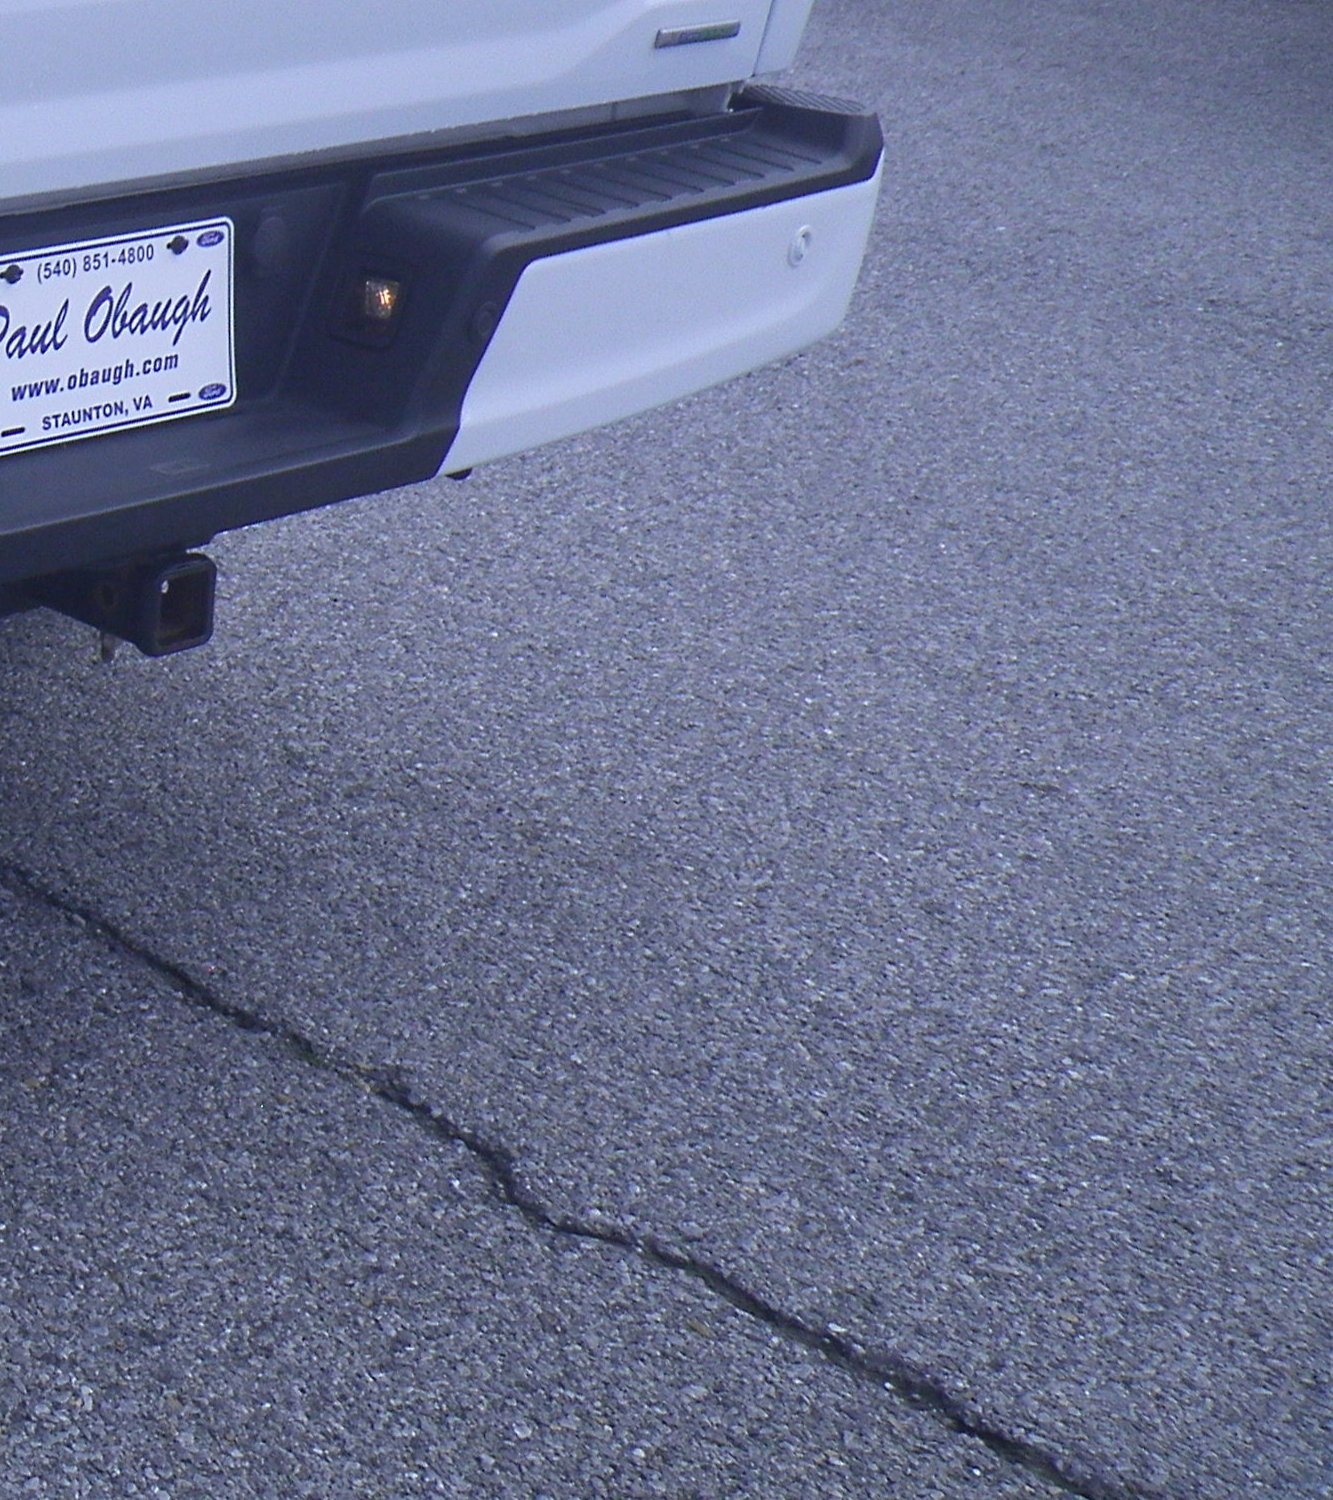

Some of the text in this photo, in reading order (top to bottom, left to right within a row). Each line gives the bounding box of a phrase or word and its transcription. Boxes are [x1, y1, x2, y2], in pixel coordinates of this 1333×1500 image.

[37, 243, 155, 284] (540) 851-4800
[83, 269, 213, 347] Obaugh
[11, 353, 180, 402] www.obaugh.com
[41, 394, 154, 431] STAUNTON, VA
